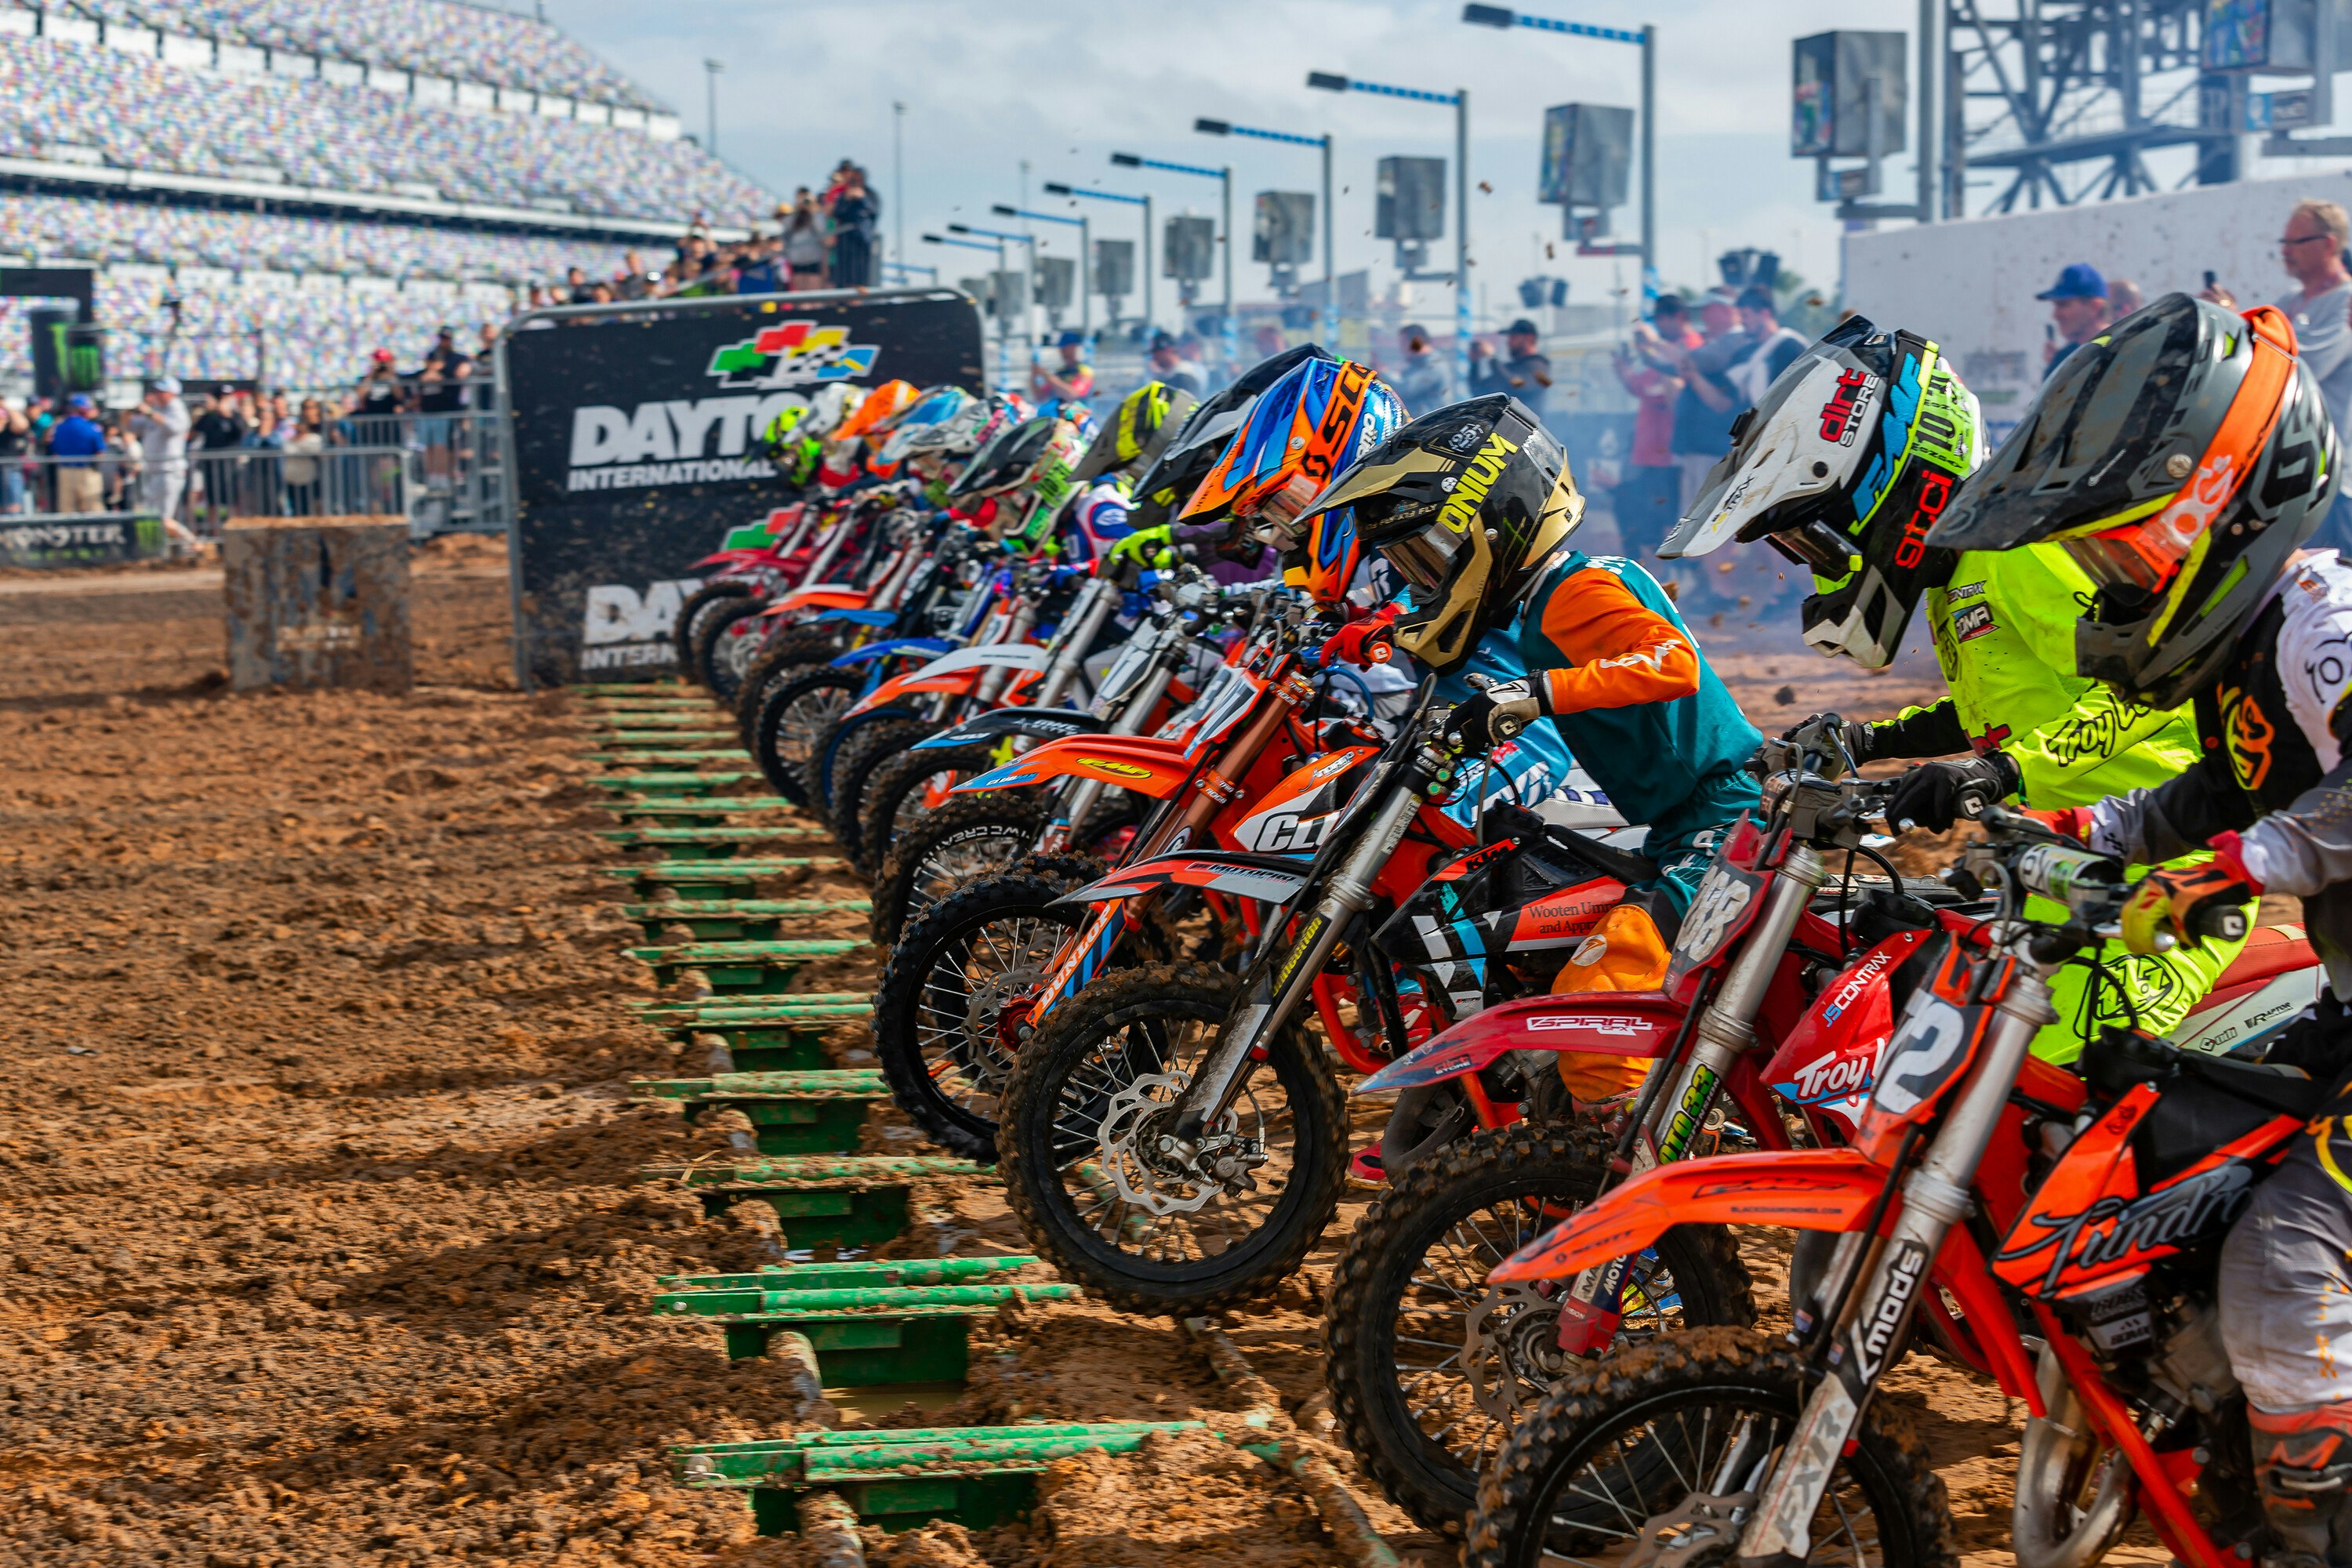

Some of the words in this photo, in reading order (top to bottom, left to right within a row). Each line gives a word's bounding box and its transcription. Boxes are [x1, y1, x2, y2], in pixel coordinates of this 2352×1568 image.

[1818, 368, 1866, 442] dirt
[1838, 373, 1880, 448] STORE
[1852, 352, 1921, 521] FMF
[2045, 709, 2116, 767] Troy
[1530, 905, 1580, 918] Wooten
[1540, 920, 1560, 934] and
[1041, 904, 1111, 1010] DUNLOP
[1682, 1063, 1715, 1117] 33
[1794, 1049, 1869, 1098] Troy
